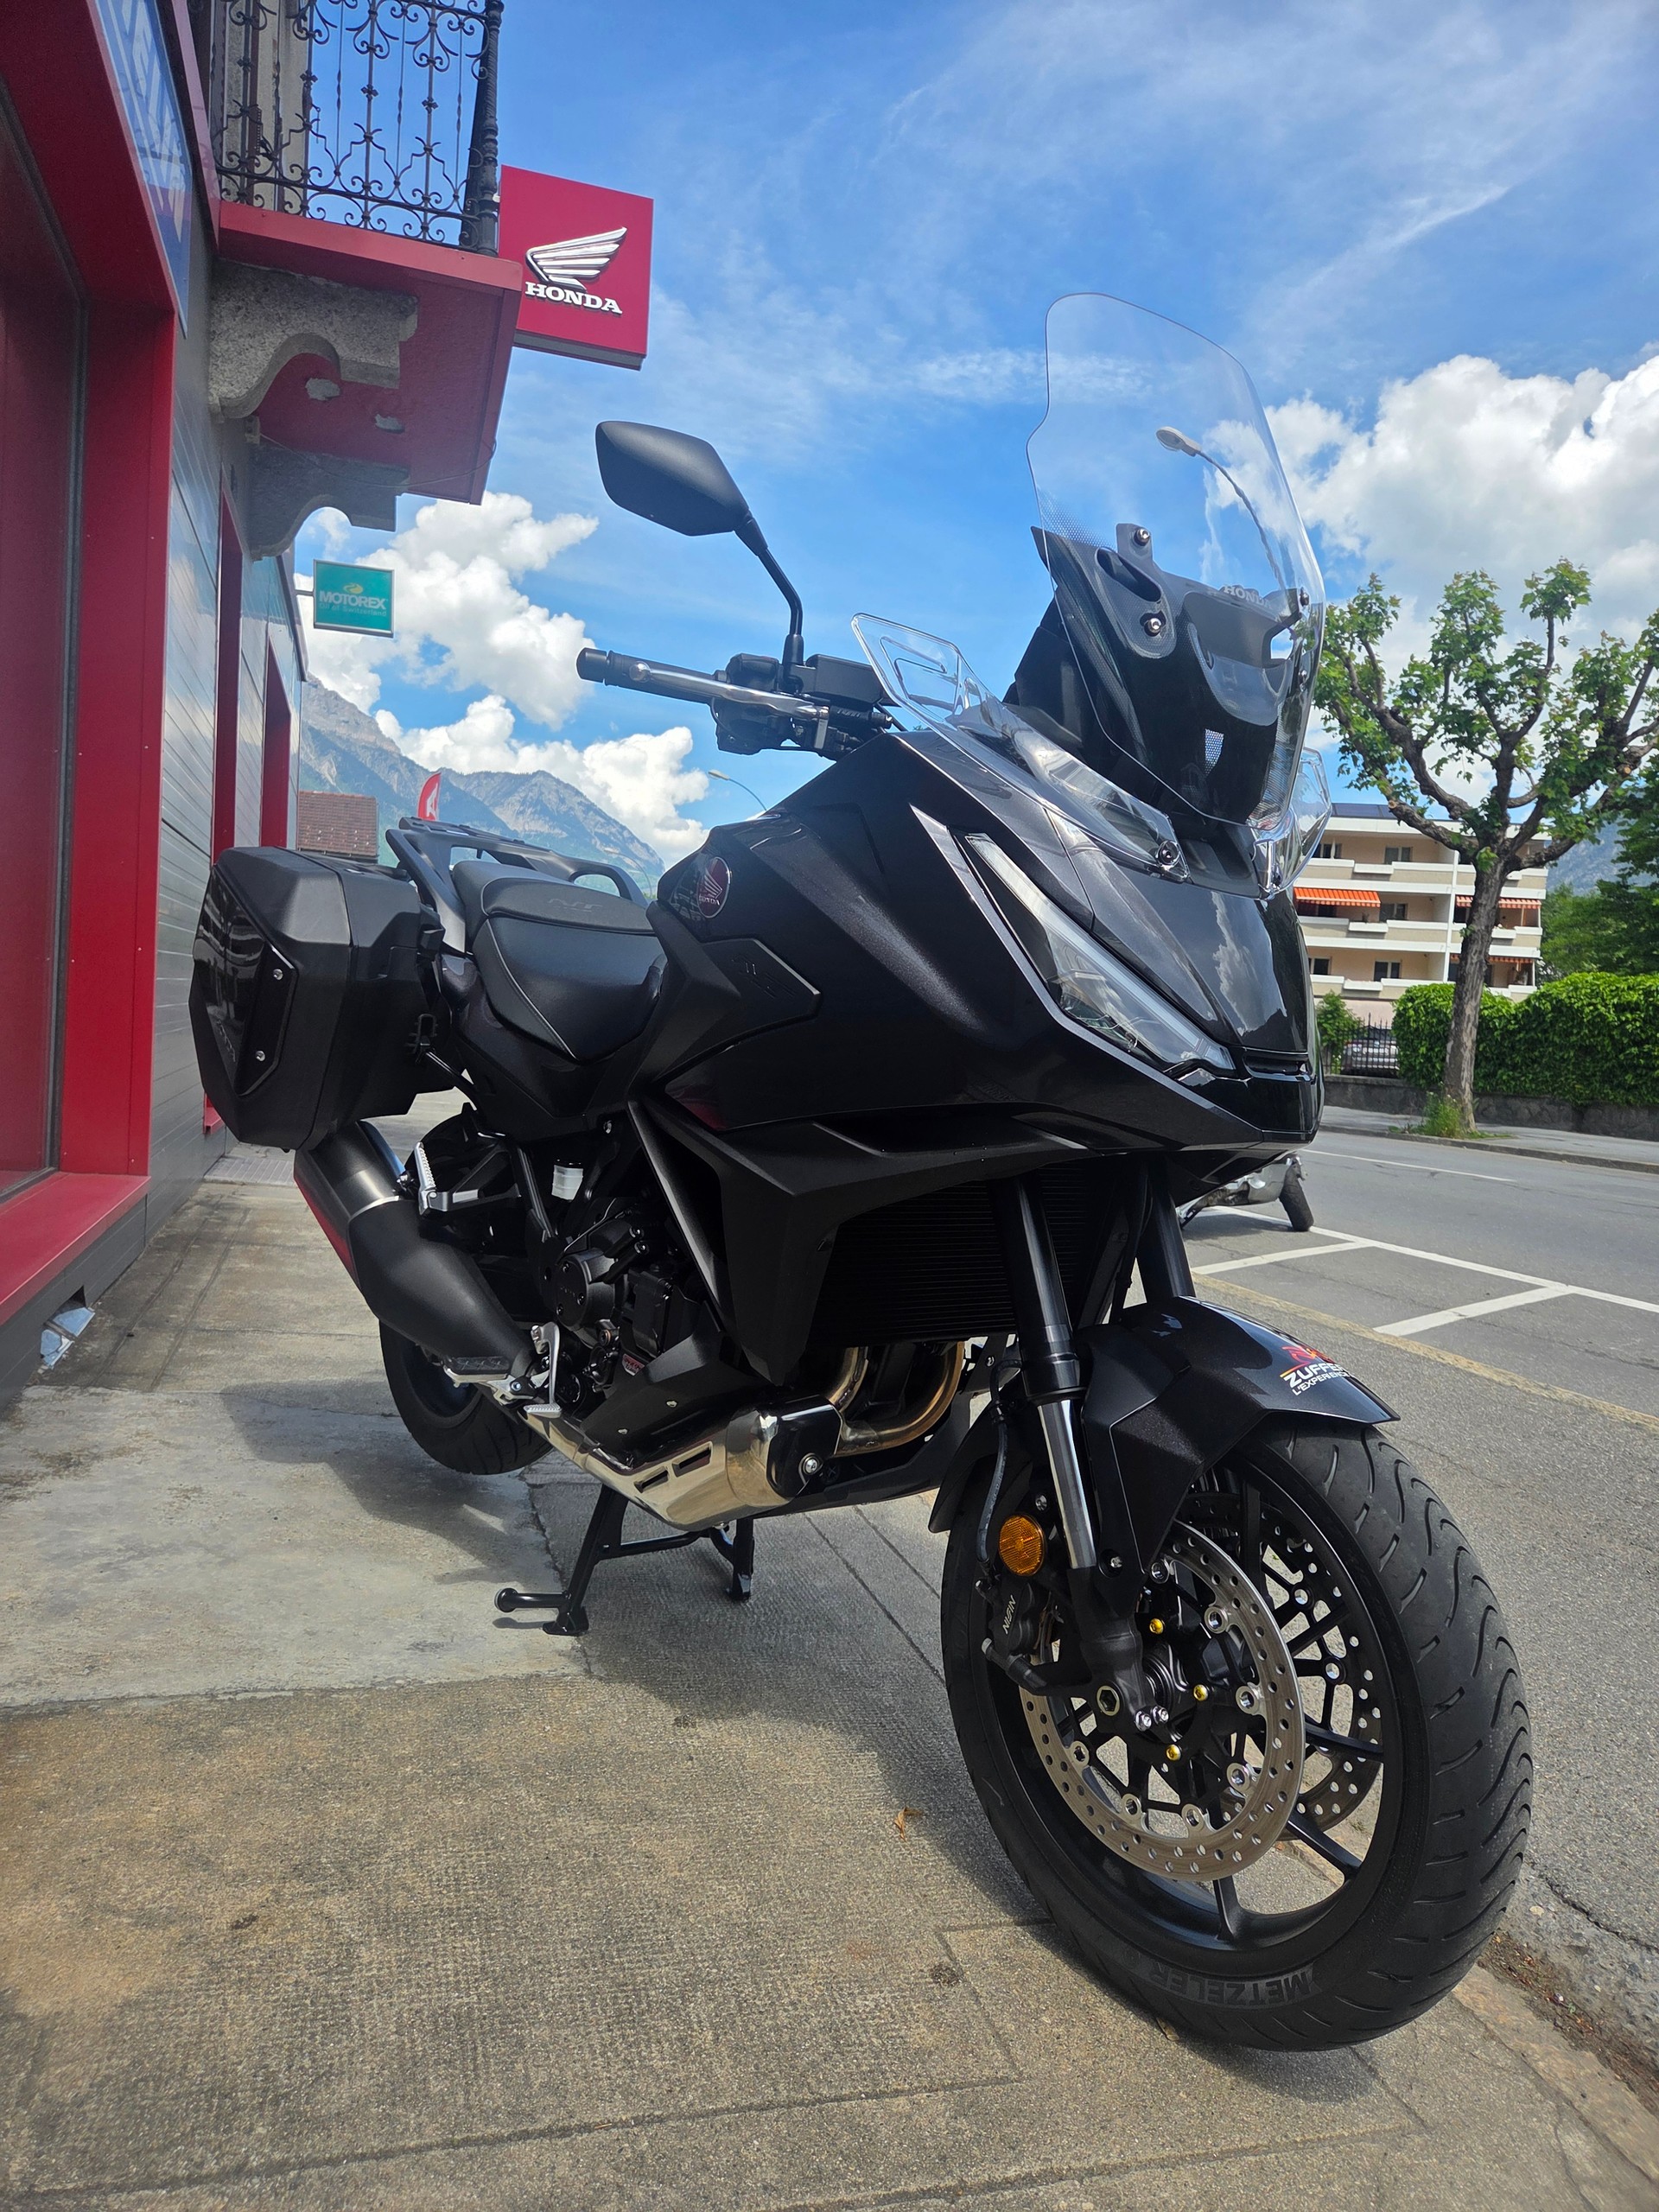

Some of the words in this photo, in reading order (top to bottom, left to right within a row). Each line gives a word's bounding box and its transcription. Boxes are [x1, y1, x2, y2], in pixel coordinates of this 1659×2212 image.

[524, 281, 623, 315] HONDA
[319, 590, 387, 610] MOTOREX
[343, 605, 387, 617] Switzerland
[1148, 1961, 1313, 2006] METZELER
